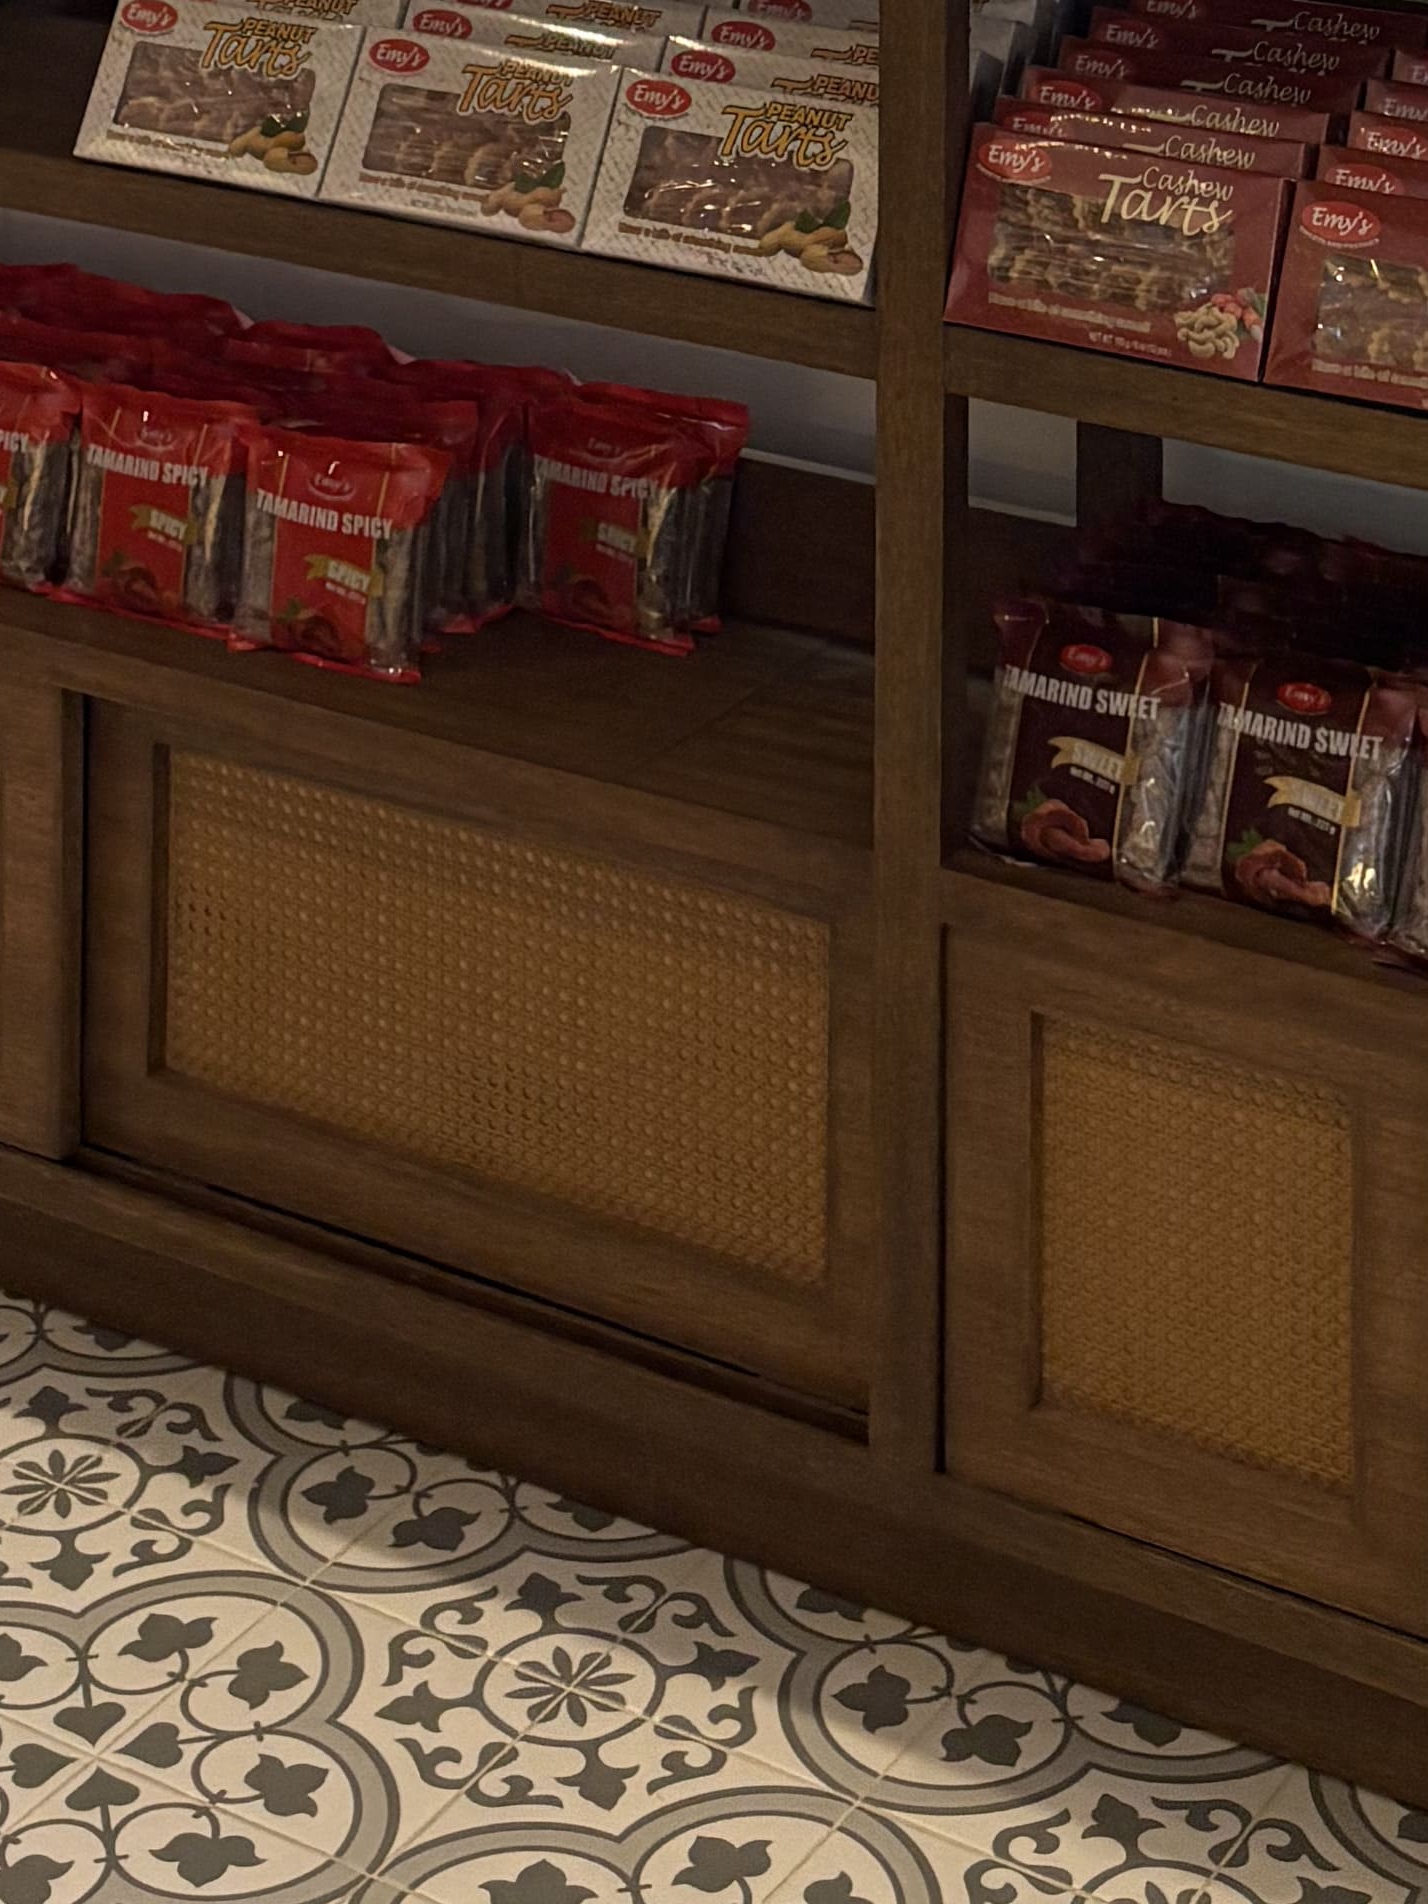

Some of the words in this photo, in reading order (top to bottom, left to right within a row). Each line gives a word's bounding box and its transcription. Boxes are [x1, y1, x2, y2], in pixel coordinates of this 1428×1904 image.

[127, 4, 172, 26] Emy's
[419, 15, 465, 37] Emy's
[584, 0, 663, 28] PEANUT
[1292, 11, 1380, 43] Cashew
[242, 18, 320, 43] PEANUT
[720, 25, 768, 50] Emy's
[200, 22, 313, 78] Tarts
[375, 45, 424, 68] Emy's
[1253, 40, 1341, 72] Cashew
[679, 55, 729, 79] Emy's
[458, 64, 573, 121] Tarts
[634, 86, 685, 111] Emy's
[1223, 73, 1312, 106] Cashew
[766, 102, 853, 132] PEANUT
[1191, 105, 1280, 137] Cashew
[720, 105, 847, 168] Tarts
[988, 145, 1046, 173] Emy's
[1164, 136, 1256, 170] Cashew
[1141, 166, 1234, 202] Cashew
[1098, 174, 1233, 237] Tarts
[1311, 206, 1373, 235] Emy's
[86, 444, 160, 482] TAMARIND
[163, 463, 209, 487] SPICY
[256, 489, 338, 531] TAMARIND
[341, 512, 393, 540] SPICY
[1003, 663, 1093, 711] TAMARIND
[1096, 688, 1161, 720] SWEET
[1218, 702, 1311, 751] TAMARIND
[1314, 726, 1384, 760] SWEET
